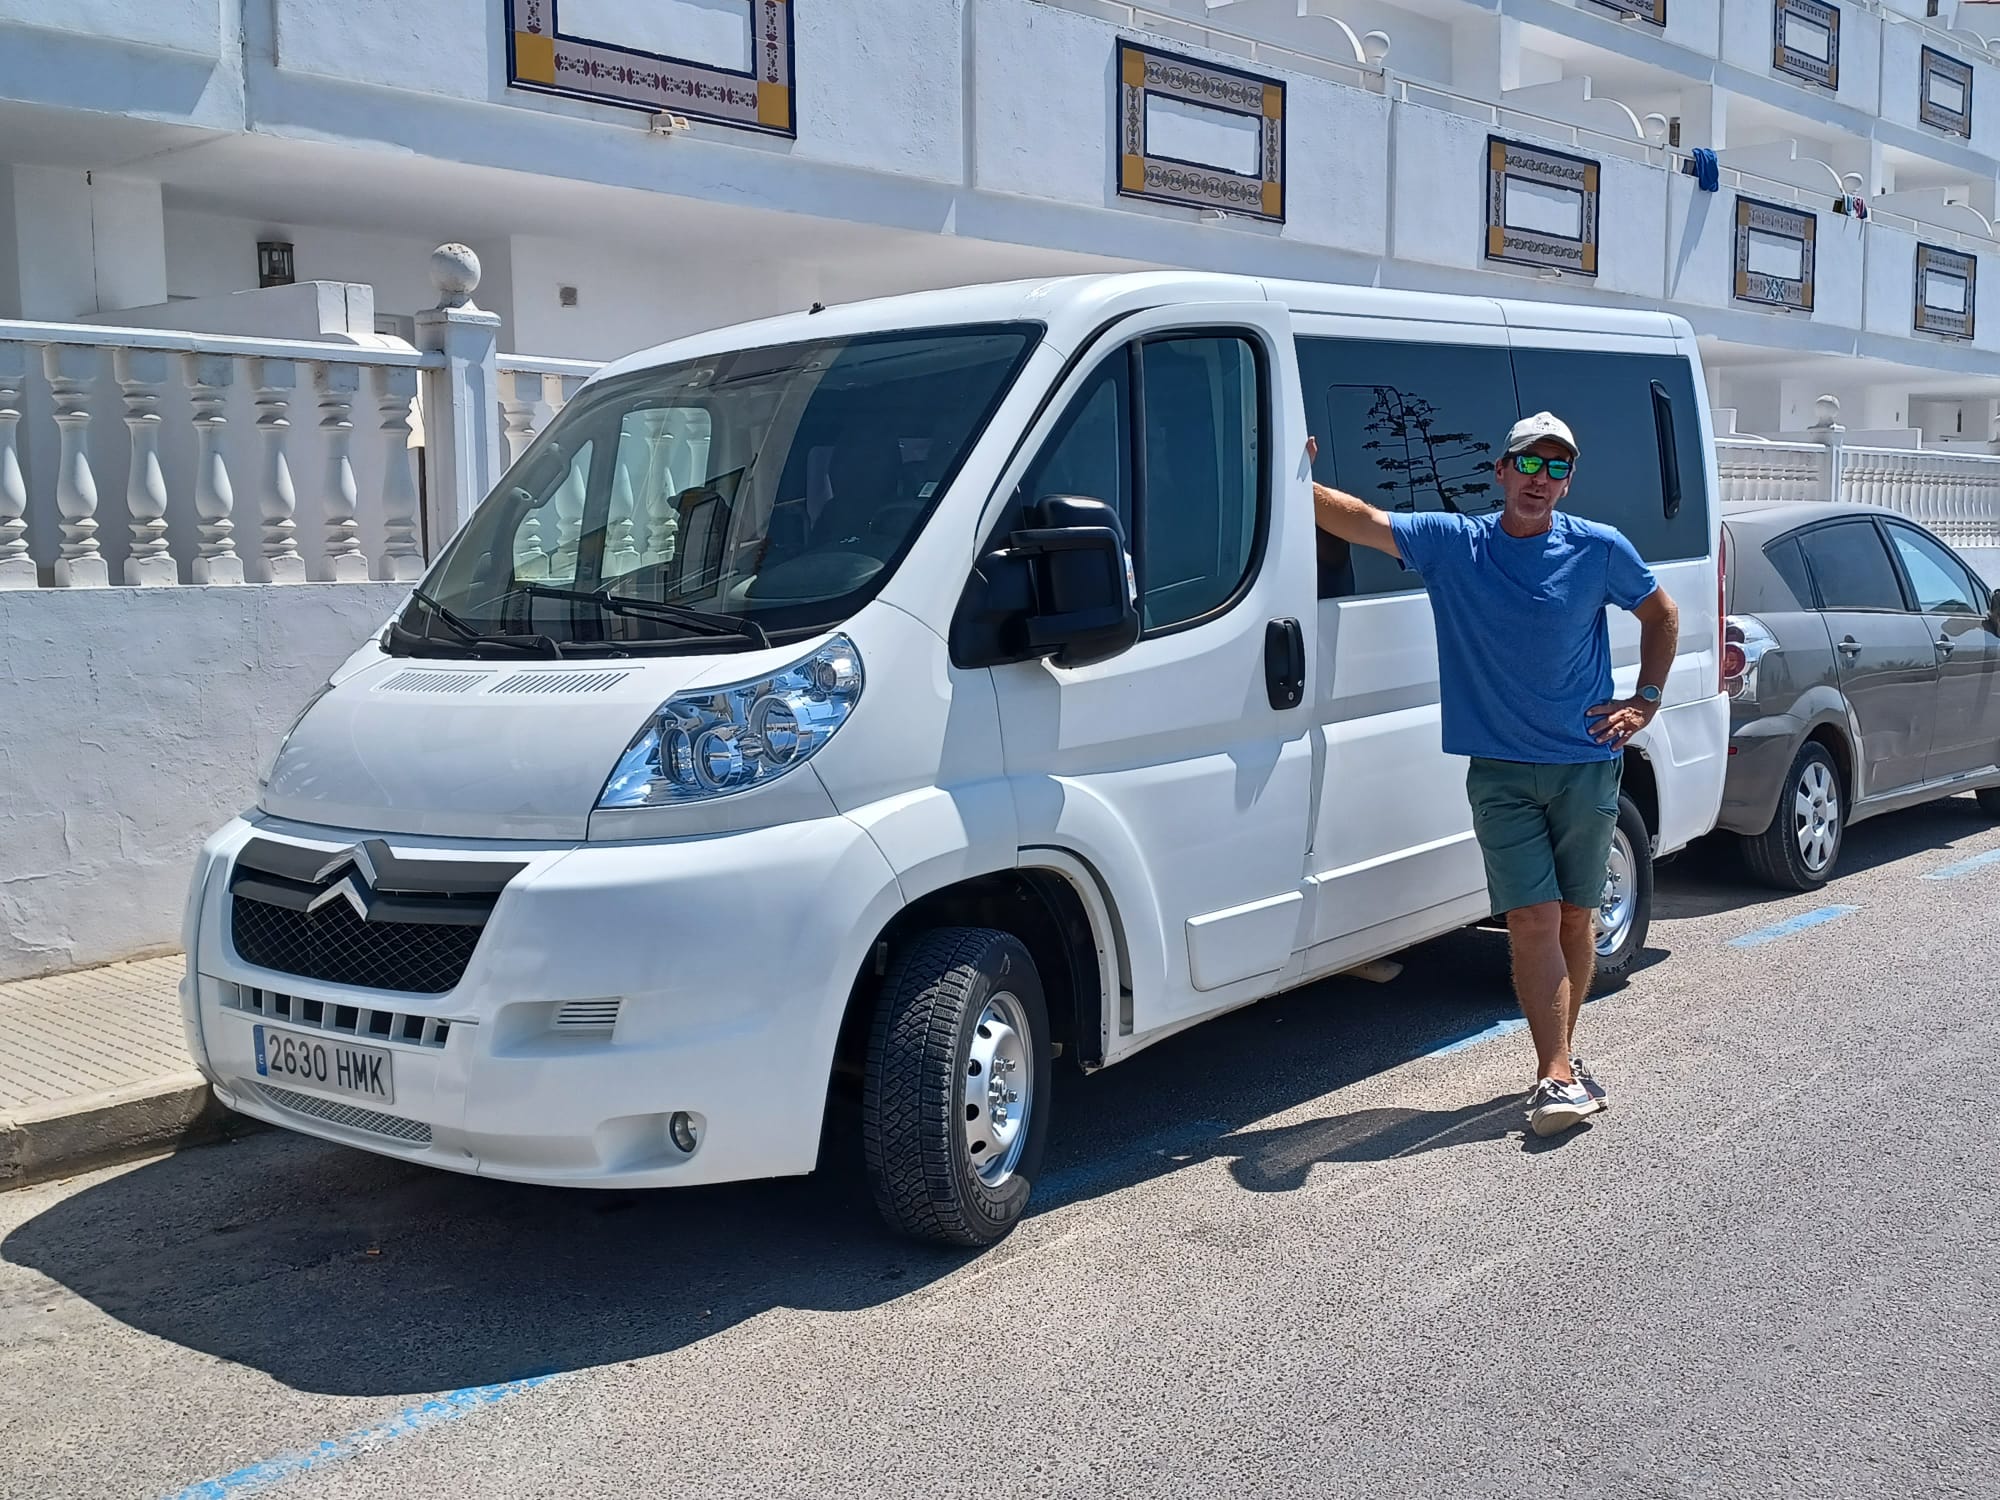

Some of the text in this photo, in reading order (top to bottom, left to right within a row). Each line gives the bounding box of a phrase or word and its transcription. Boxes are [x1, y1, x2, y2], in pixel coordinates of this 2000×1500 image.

[258, 1053, 265, 1065] E
[269, 1034, 385, 1096] 2630 HMK
